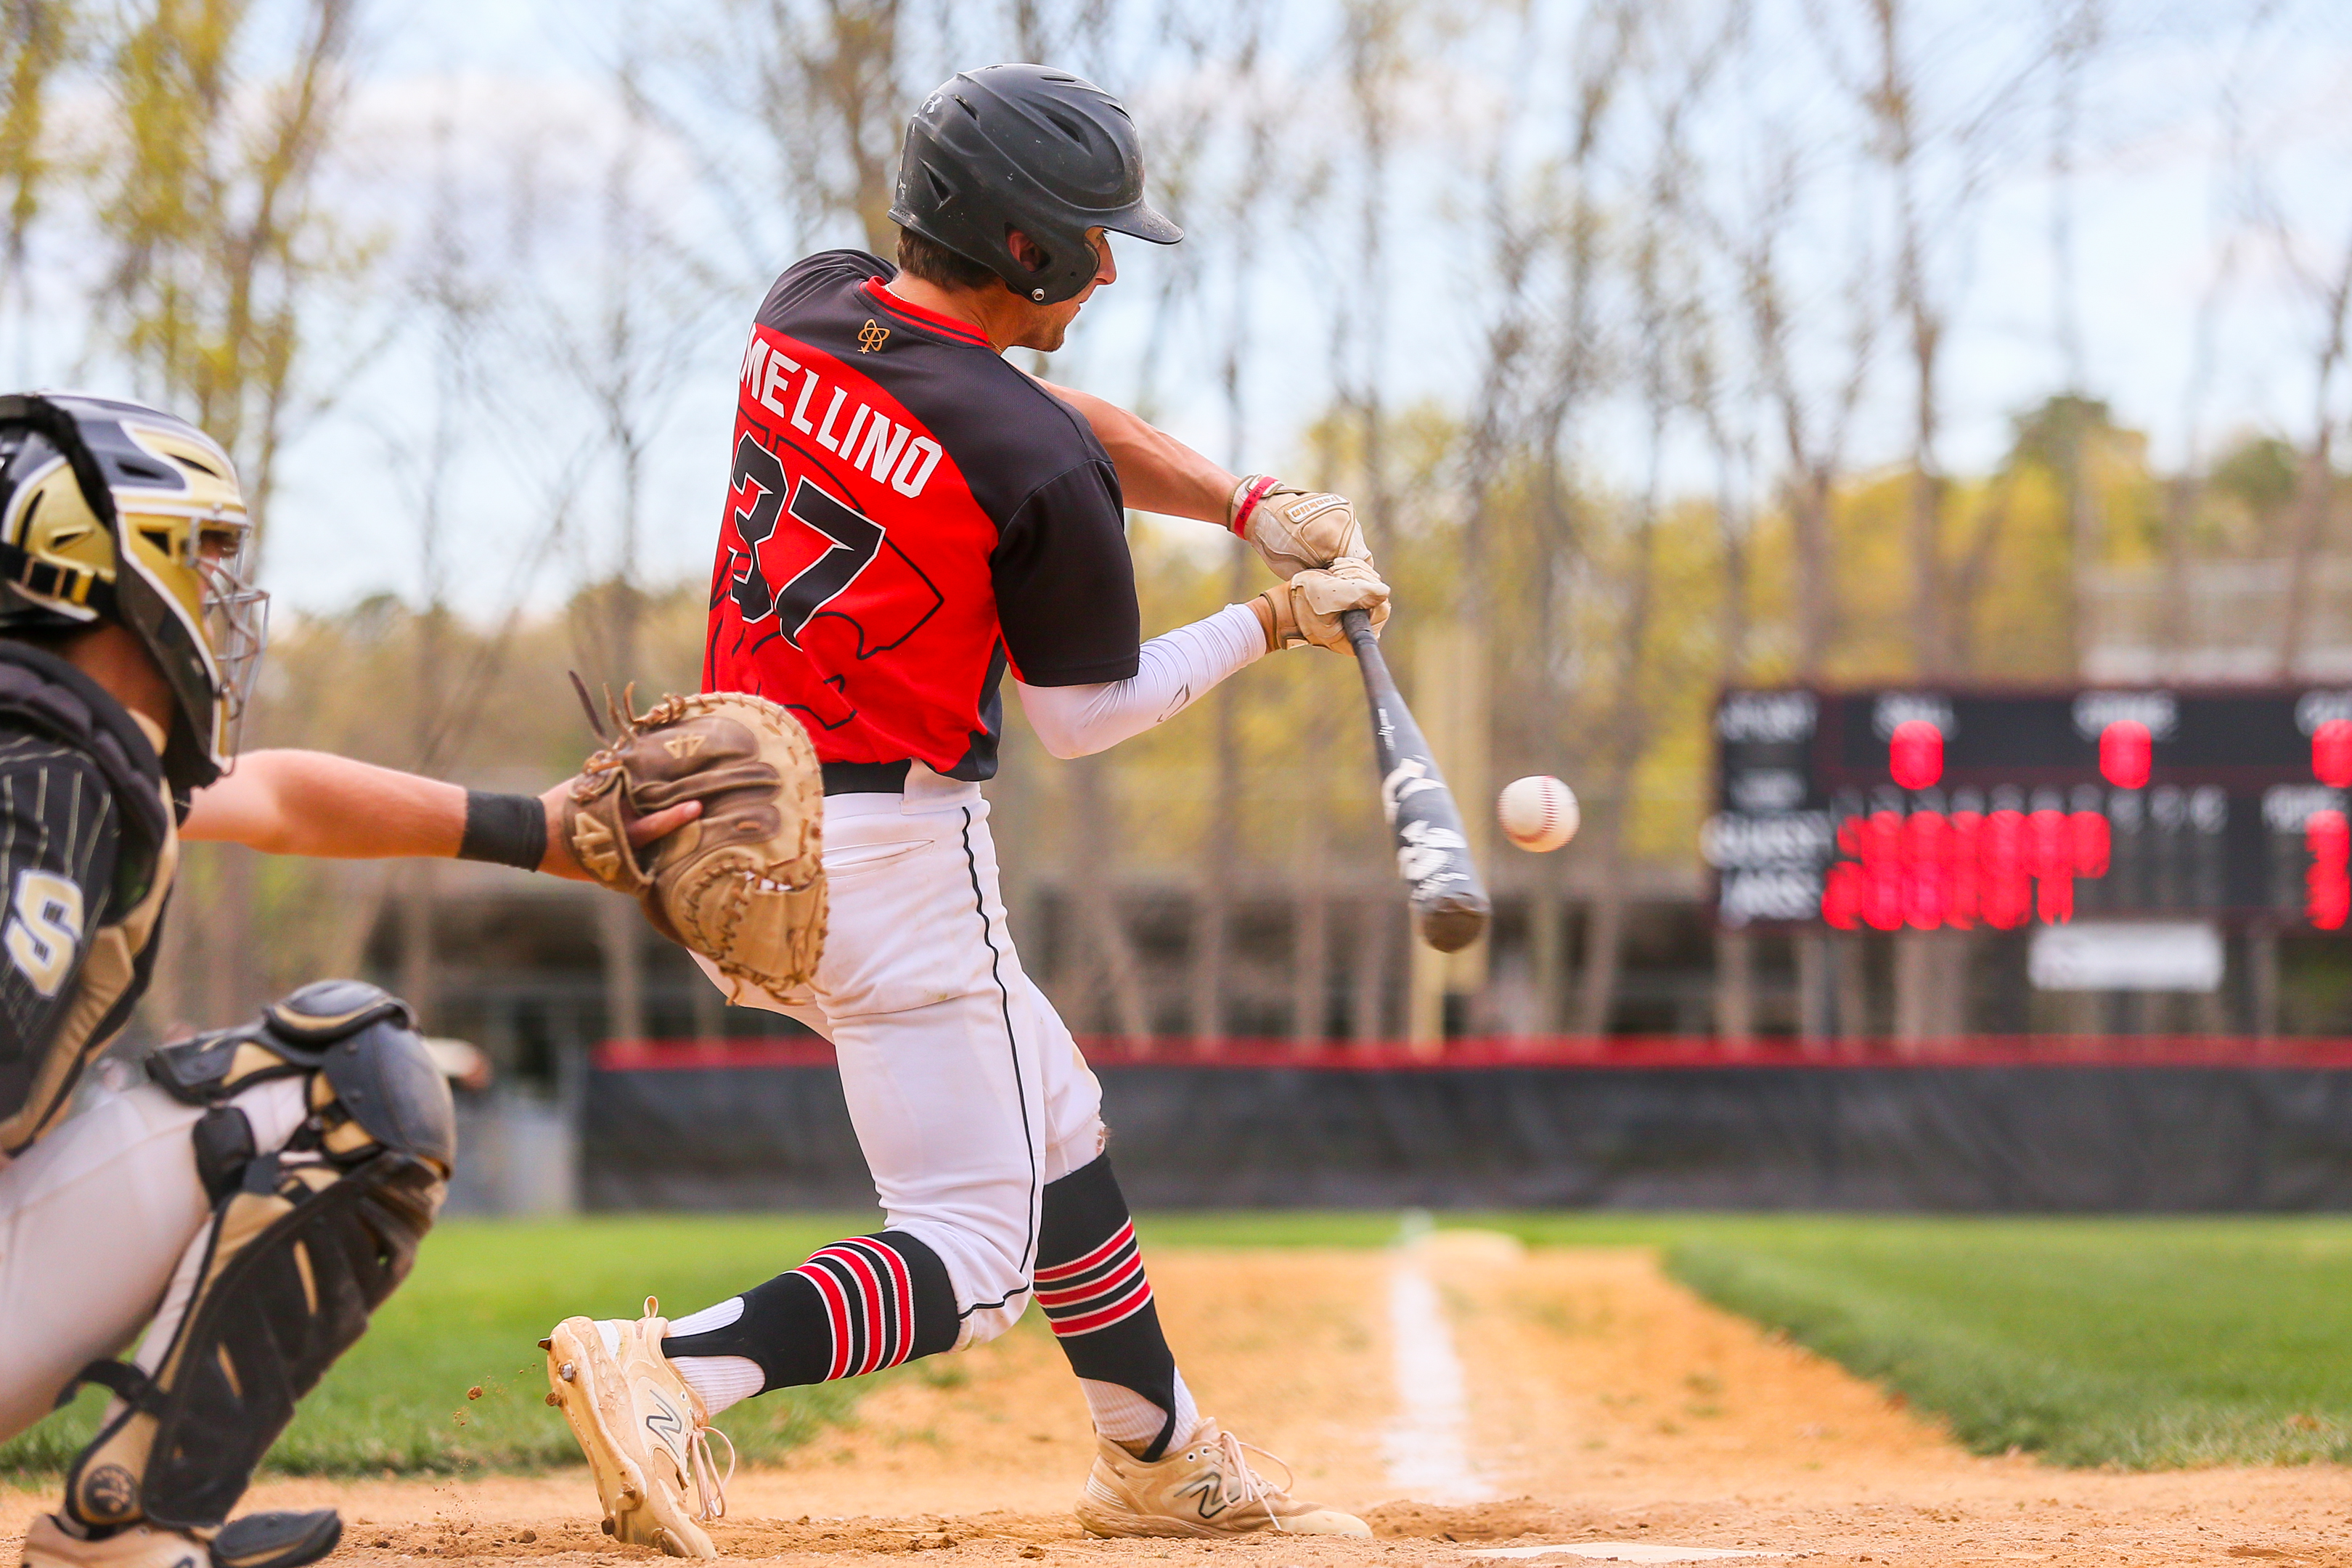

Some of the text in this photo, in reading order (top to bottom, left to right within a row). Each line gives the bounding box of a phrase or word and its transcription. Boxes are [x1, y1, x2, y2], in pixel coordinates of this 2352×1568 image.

[739, 322, 943, 499] MELLINO
[727, 430, 887, 652] 37
[4, 870, 85, 997] S
